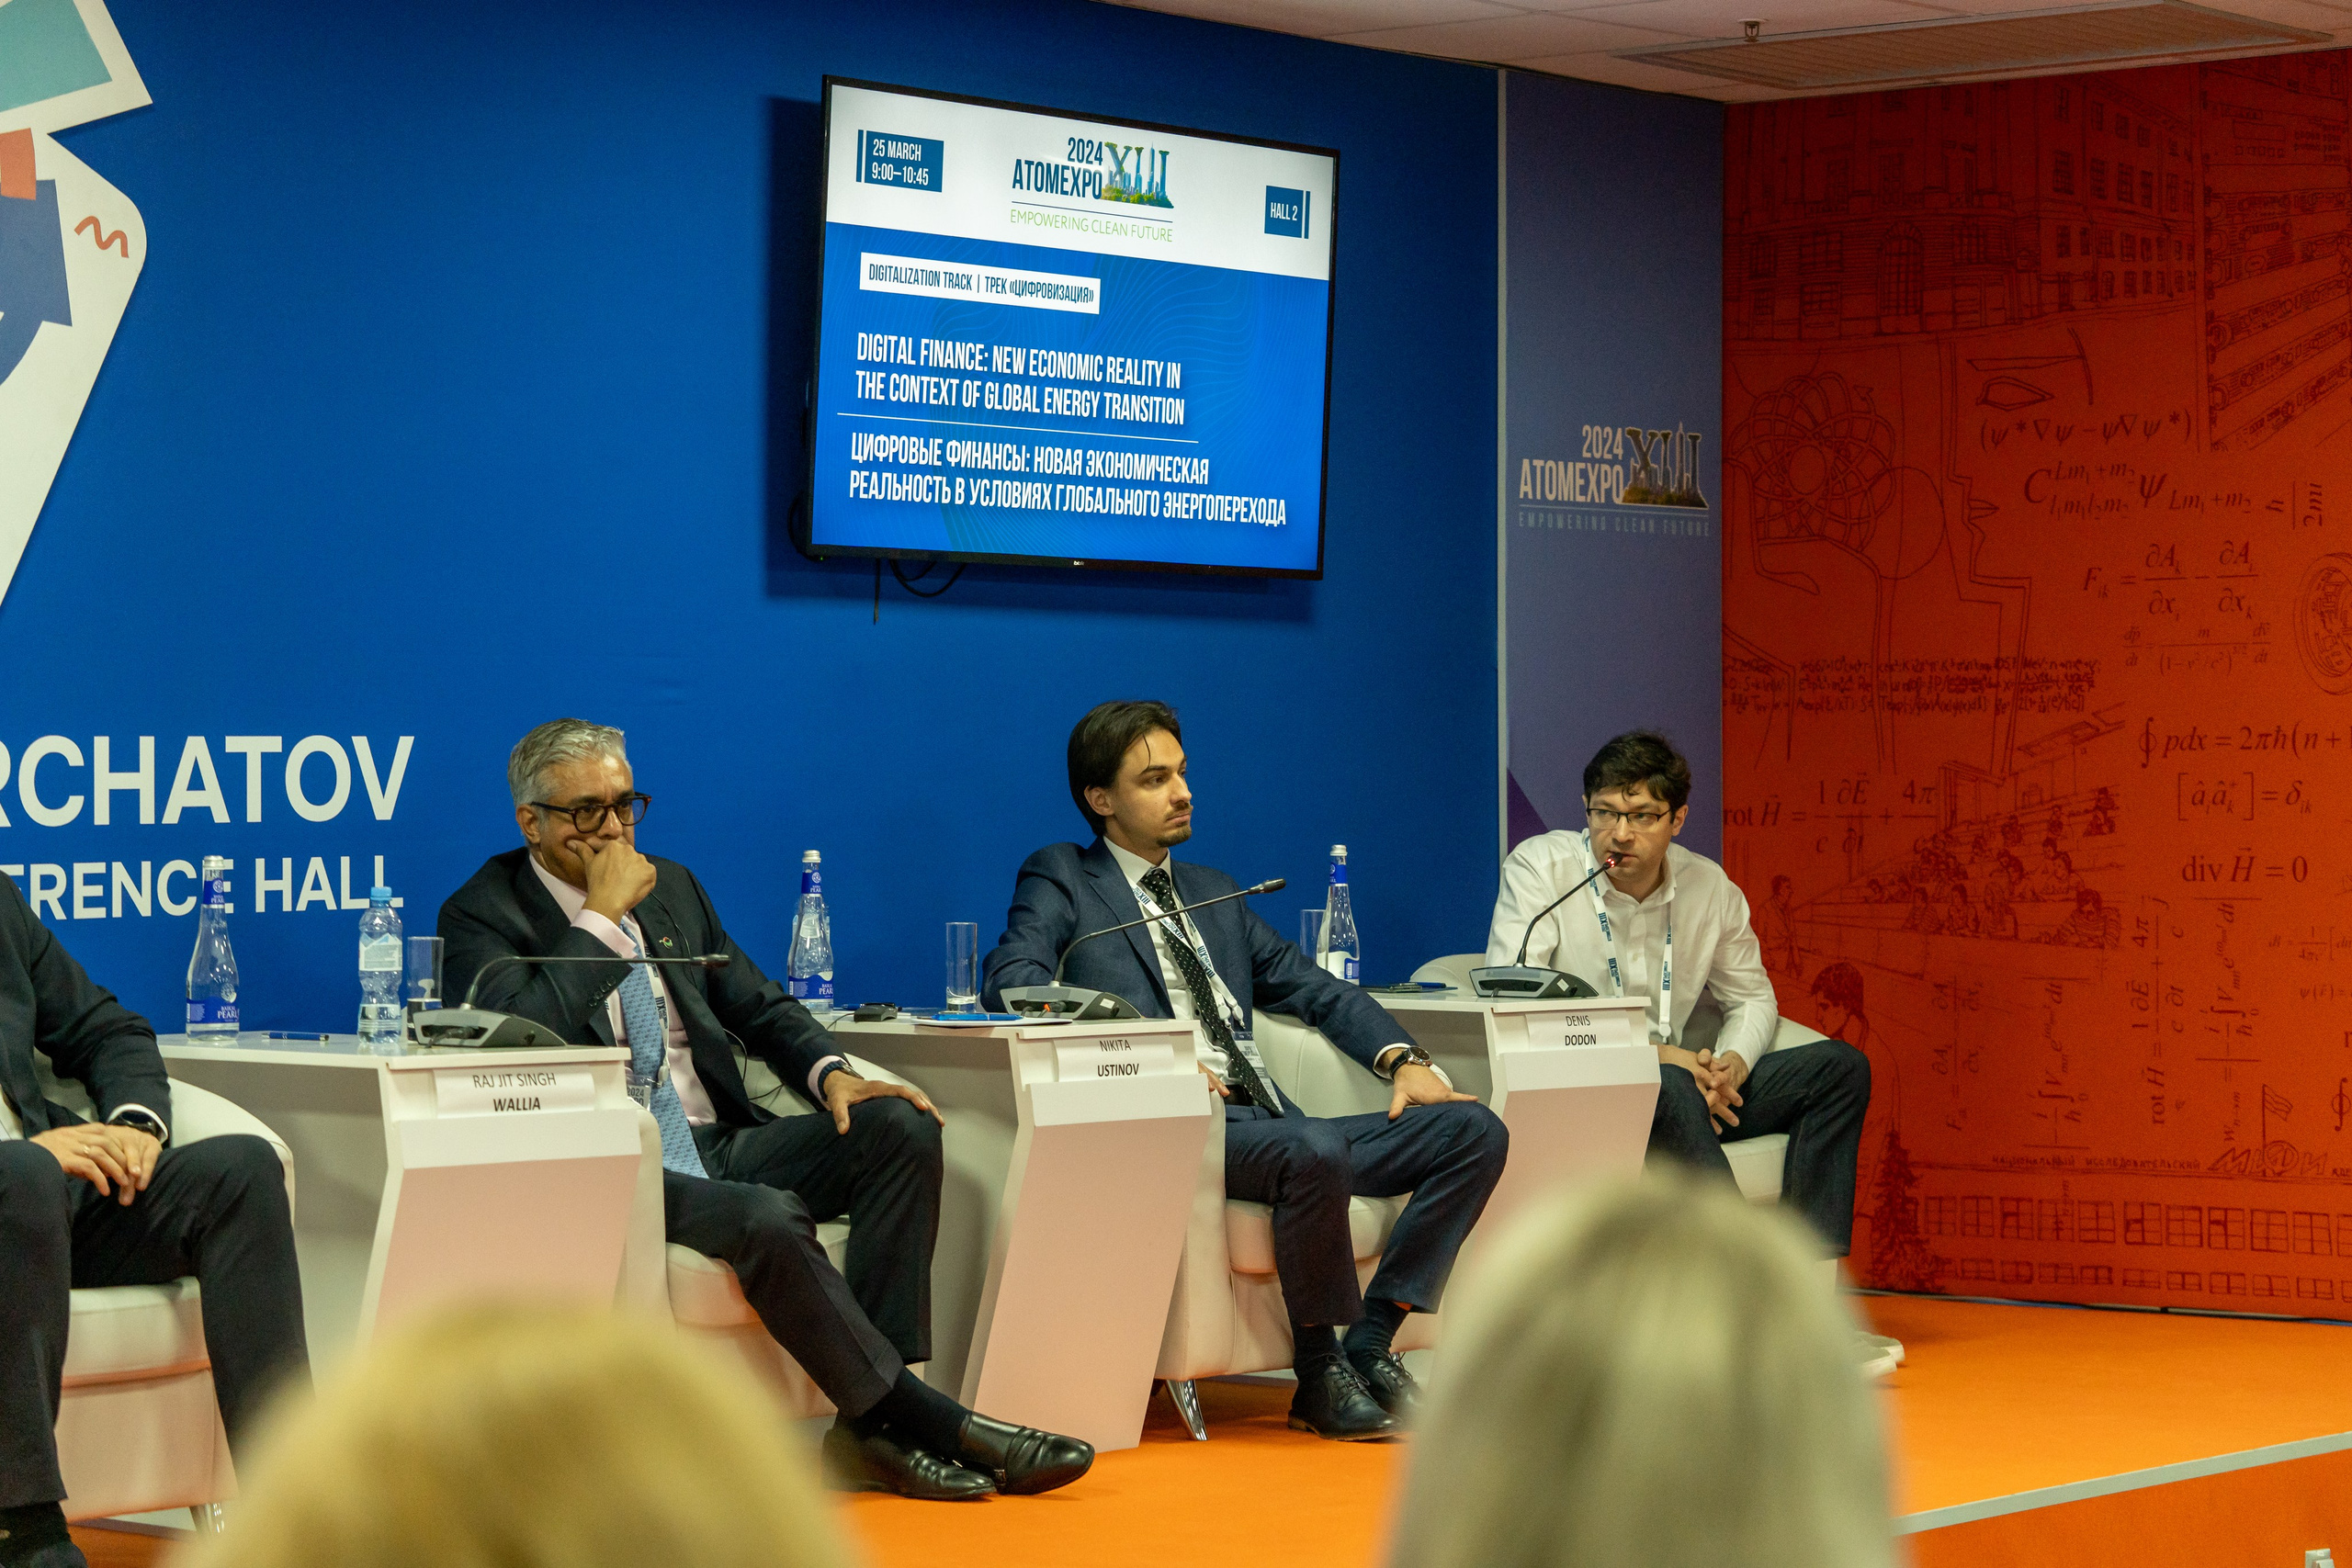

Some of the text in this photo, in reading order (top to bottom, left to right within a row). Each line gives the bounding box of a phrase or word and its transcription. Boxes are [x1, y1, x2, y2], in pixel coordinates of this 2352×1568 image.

[873, 139, 922, 162] 25 MARCH
[1068, 137, 1103, 165] 2024
[1012, 159, 1103, 199] ATOMEXPO
[1270, 202, 1298, 221] HALL 2
[1011, 209, 1173, 243] EMPOWERING CLEAN FUTURE
[869, 264, 973, 291] DIGITALIZATION TRACK
[985, 276, 1094, 305] ТРЕК «ЦИФРОВИЗАЦИЯ»
[856, 332, 1182, 389] DIGITAL FINANCE: NEW ECONOMIC REALITY IN
[855, 370, 1185, 425] THE CONTEXT OF GLOBAL ENERGY TRANSITION
[1582, 424, 1623, 459] 2024
[851, 432, 1209, 485] ЦИФРОВЫЕ ФИНАНСЫ: НОВАЯ ЭКОНОМИЧЕСКАЯ
[1519, 458, 1624, 504] ATOMEXPO
[849, 469, 1286, 527] РЕАЛЬНОСТЬ В УСЛОВИЯХ ГЛОБАЛЬНОГО ЭНЕРГОПЕРЕХОДА
[1519, 512, 1709, 537] EMPOWERING CLEAN FUTURE
[0, 735, 415, 828] CHATOV
[255, 854, 404, 913] HALL
[1566, 1015, 1590, 1027] DENIS
[1100, 1039, 1131, 1052] NIKITA
[1565, 1034, 1597, 1046] DODON
[473, 1072, 557, 1089] RAJ JIT SINGH
[1097, 1063, 1139, 1077] USTINOV
[493, 1097, 541, 1111] WALLIA
